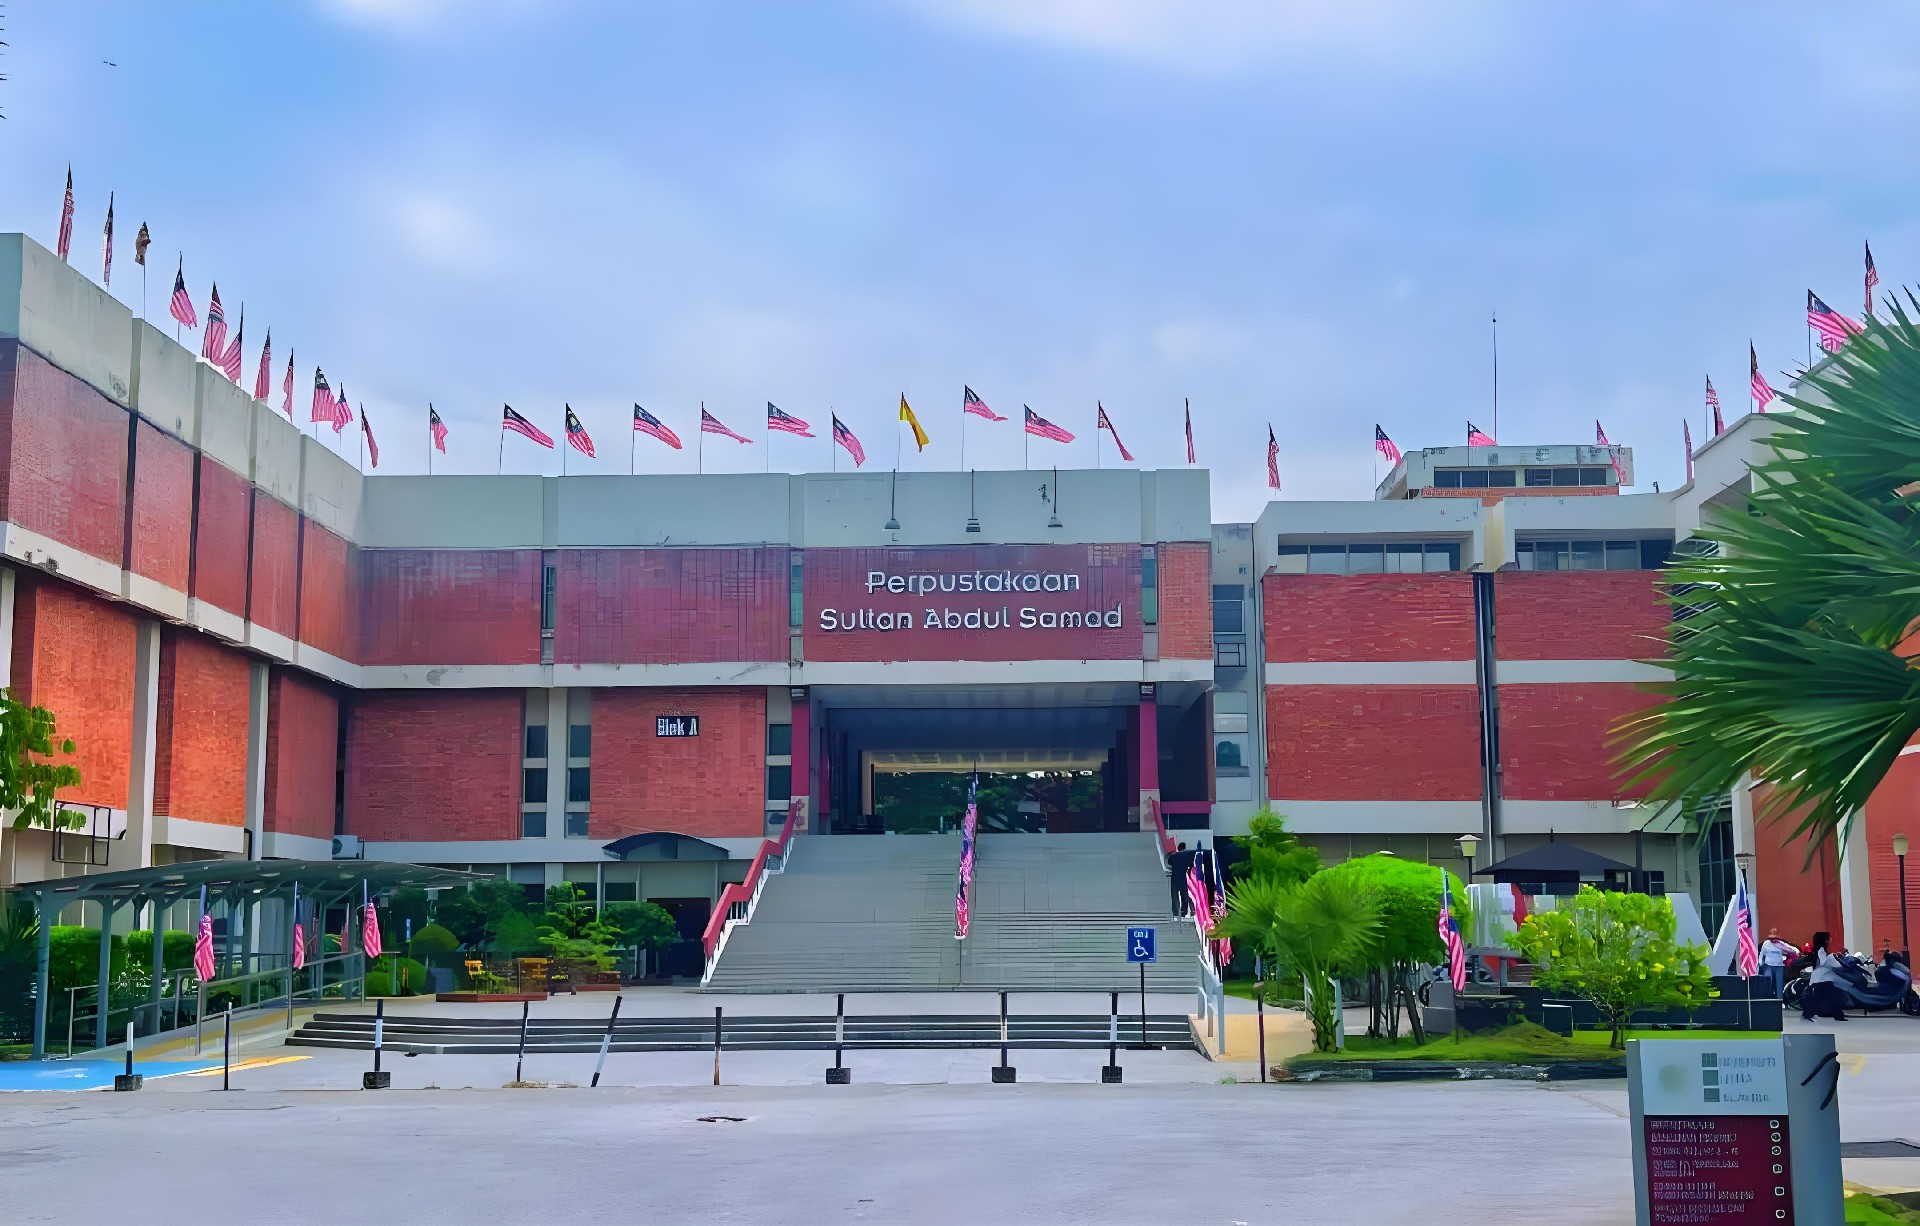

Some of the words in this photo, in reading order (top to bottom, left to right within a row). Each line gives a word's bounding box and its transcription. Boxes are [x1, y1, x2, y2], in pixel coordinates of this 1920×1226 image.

[866, 570, 1080, 596] Perpustakaan
[820, 608, 913, 629] Sultan
[923, 606, 1011, 629] Abdul
[1018, 604, 1123, 629] Samad
